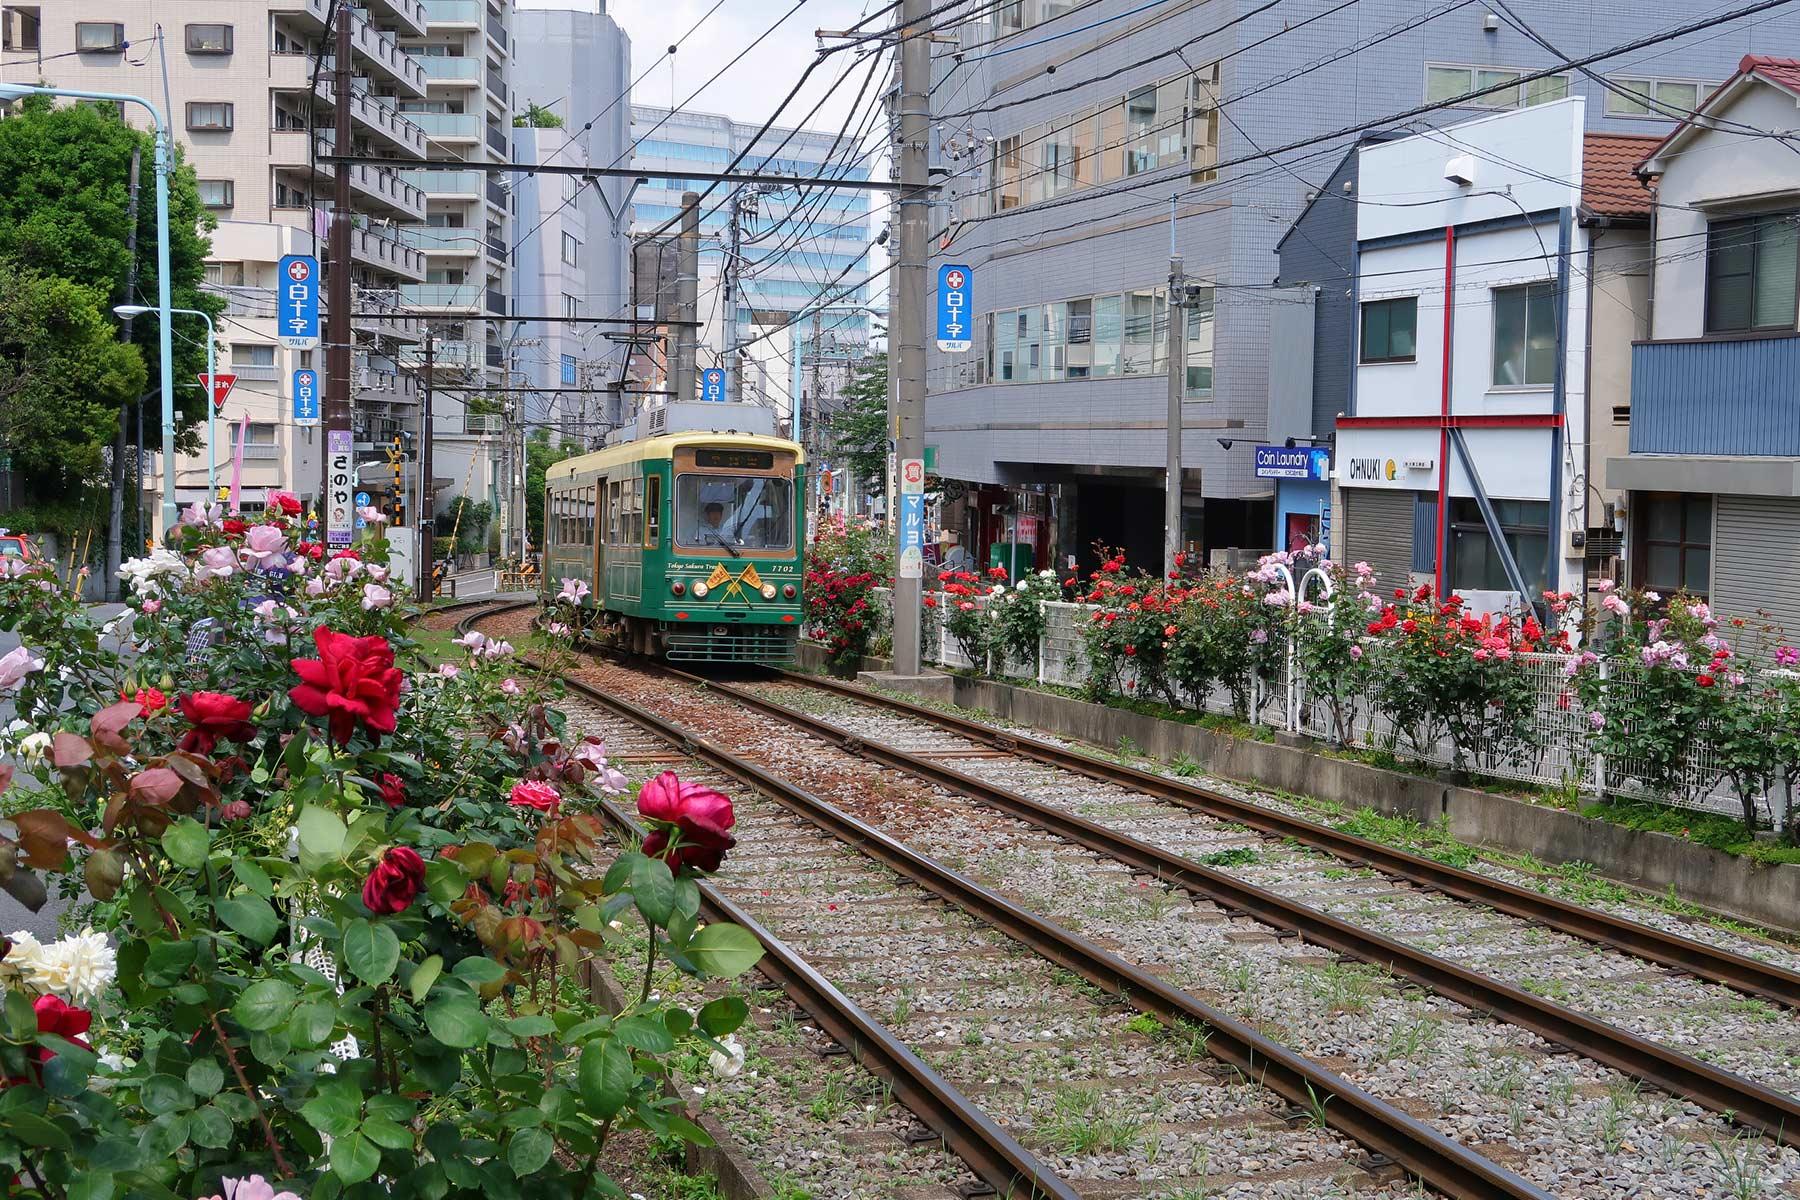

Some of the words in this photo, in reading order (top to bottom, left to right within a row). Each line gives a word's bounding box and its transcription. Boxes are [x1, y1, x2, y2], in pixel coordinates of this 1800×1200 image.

[289, 282, 309, 335] 白十字
[946, 290, 963, 338] 白十字
[299, 386, 313, 417] 白十字
[708, 384, 720, 402] 白十
[1257, 450, 1276, 466] Coin
[1276, 450, 1309, 469] Laundry
[1350, 457, 1381, 480] OHNUKI
[333, 455, 348, 505] さのや
[906, 495, 920, 545] マルヨ
[667, 562, 684, 570] Tokyo
[772, 565, 794, 573] 7702
